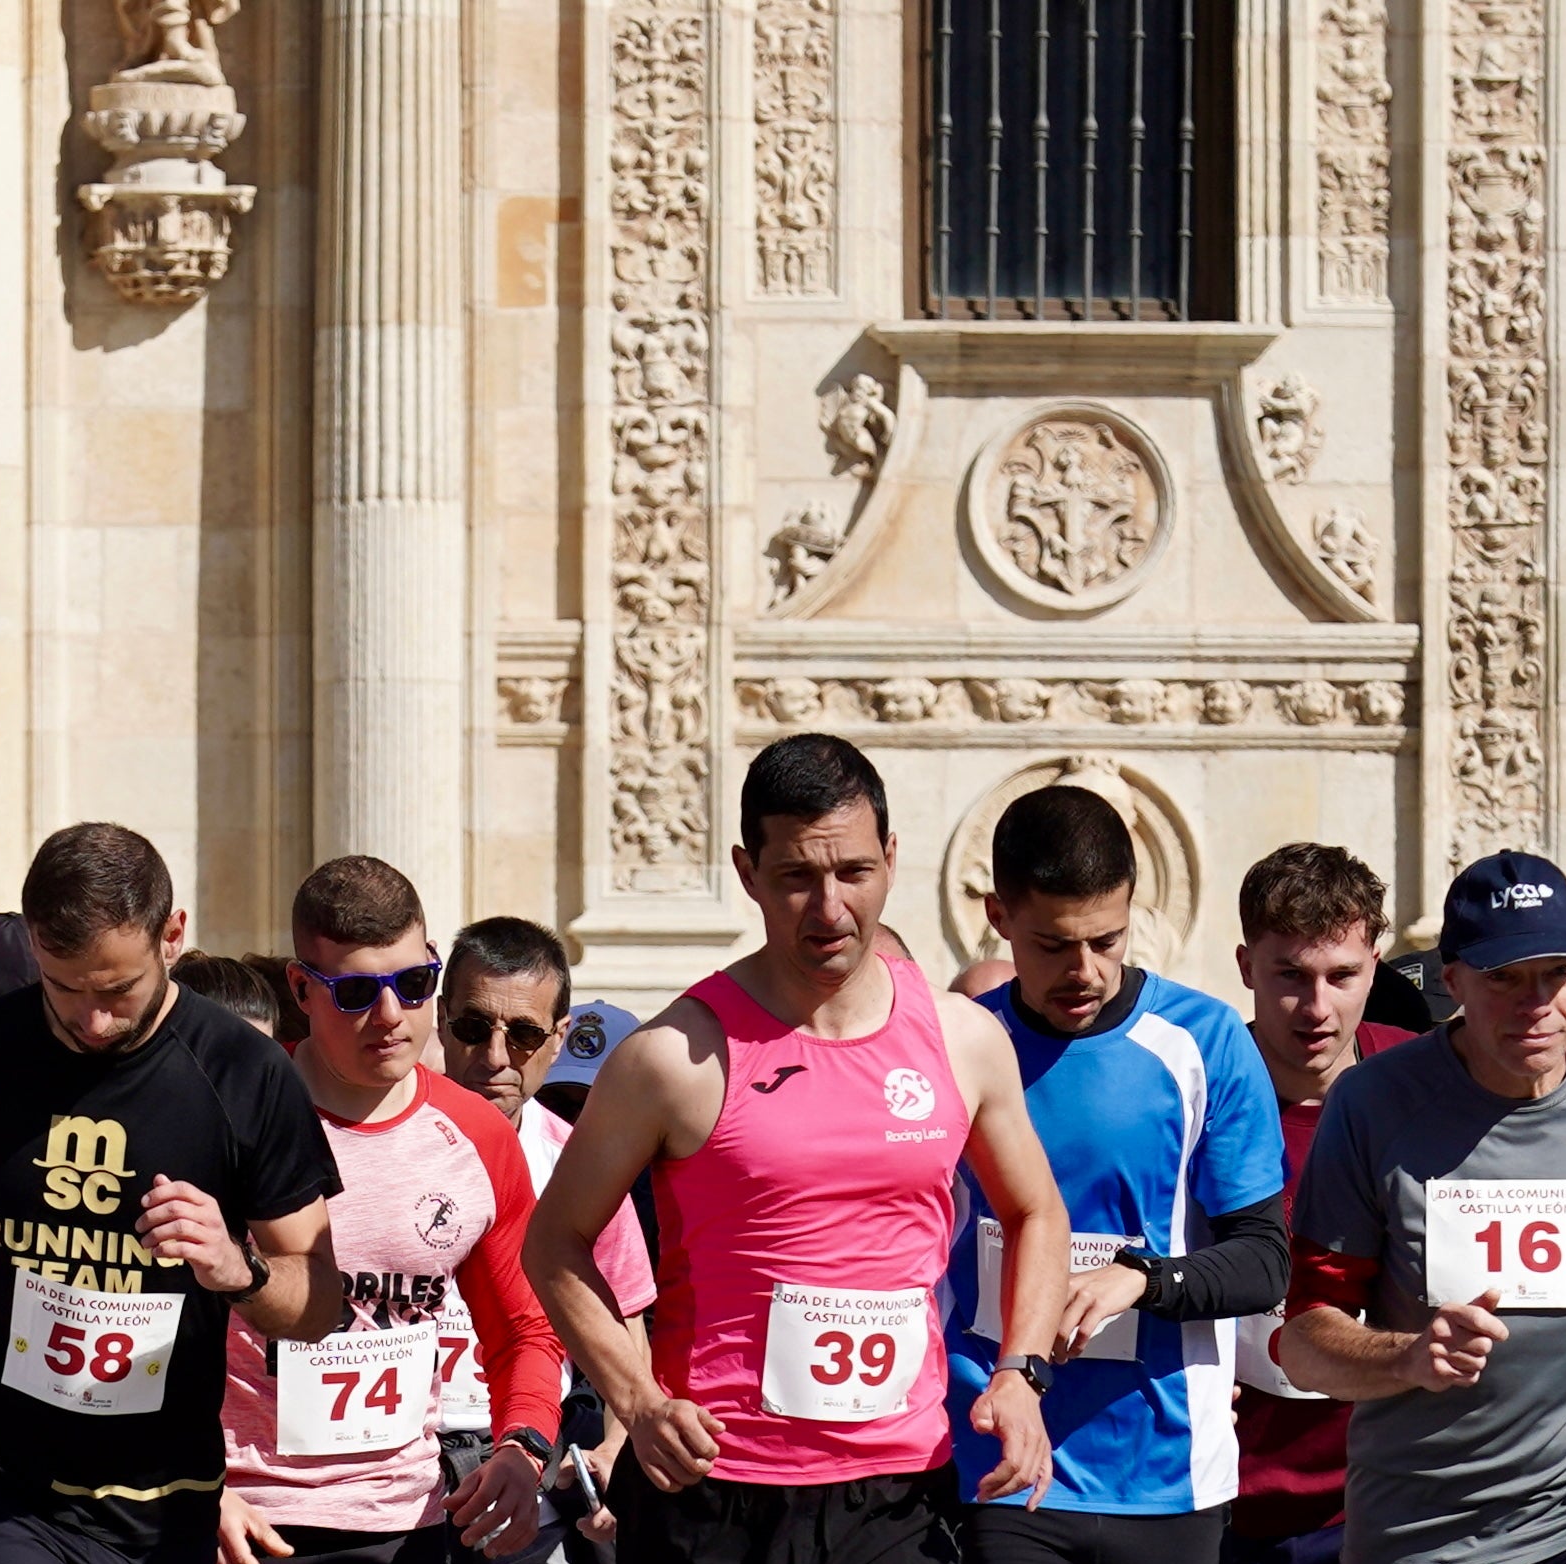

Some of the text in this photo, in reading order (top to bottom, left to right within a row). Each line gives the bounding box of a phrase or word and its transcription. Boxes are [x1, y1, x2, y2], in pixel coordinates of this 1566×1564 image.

[1438, 1187, 1461, 1200] DÍA
[1466, 1189, 1482, 1199] DE
[1488, 1189, 1504, 1199] LA
[1459, 1203, 1521, 1214] CASTILLA
[1526, 1204, 1532, 1214] Y
[1475, 1220, 1562, 1273] 16
[11, 1256, 143, 1294] TEAM
[26, 1279, 172, 1312] DÍA DE LA COMUNIDAD
[783, 1291, 922, 1311] DÍA DE LA COMUNIDAD
[42, 1301, 151, 1326] CASTILLA Y LEÓN
[449, 1309, 464, 1317] LA
[804, 1311, 909, 1327] CASTILLA Y LEÓN
[44, 1321, 134, 1383] 58
[317, 1341, 333, 1352] DE
[337, 1340, 353, 1350] LA
[356, 1331, 428, 1349] COMUNIDAD
[309, 1348, 413, 1366] CASTILLA Y LEÓN
[810, 1330, 896, 1387] 39
[321, 1367, 402, 1421] 74
